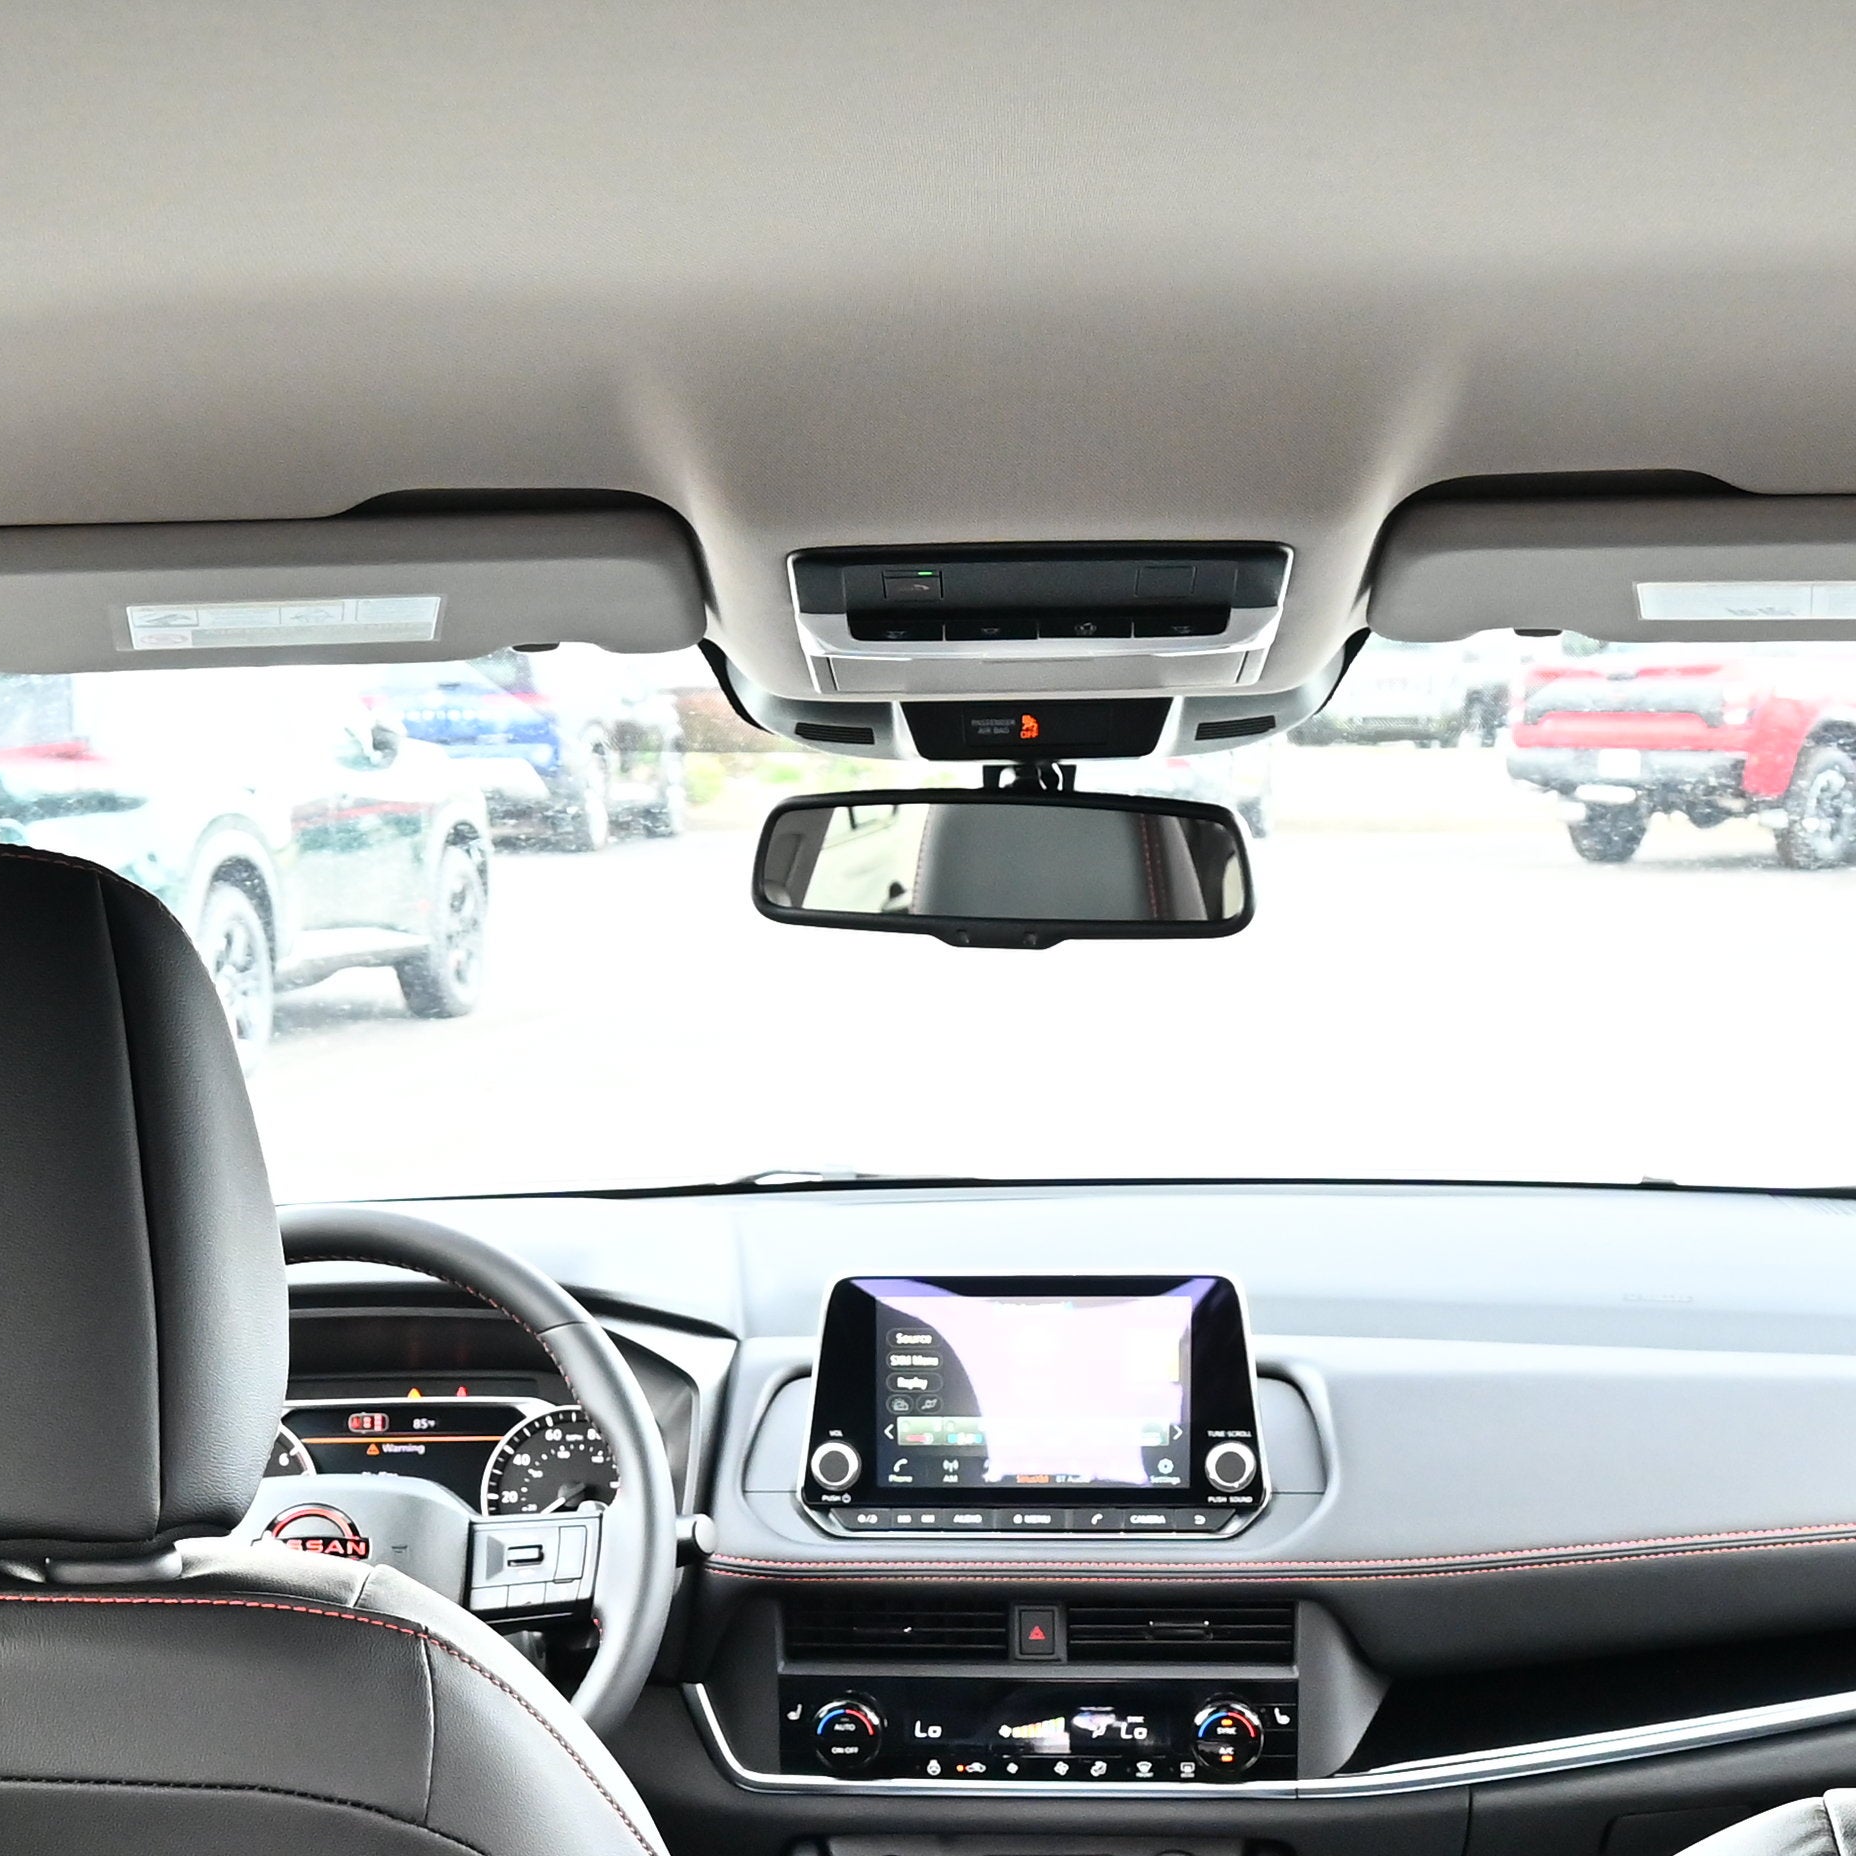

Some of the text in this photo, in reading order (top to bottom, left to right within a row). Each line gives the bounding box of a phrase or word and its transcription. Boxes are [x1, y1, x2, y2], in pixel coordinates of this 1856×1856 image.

[545, 1428, 562, 1441] 60
[382, 1444, 426, 1456] Warning
[278, 1452, 290, 1467] 6
[512, 1453, 531, 1466] 40
[500, 1490, 519, 1503] 20
[271, 1538, 366, 1556] SSAN
[834, 1723, 856, 1732] AUTO
[914, 1719, 942, 1738] Lo
[1120, 1721, 1148, 1739] Lo
